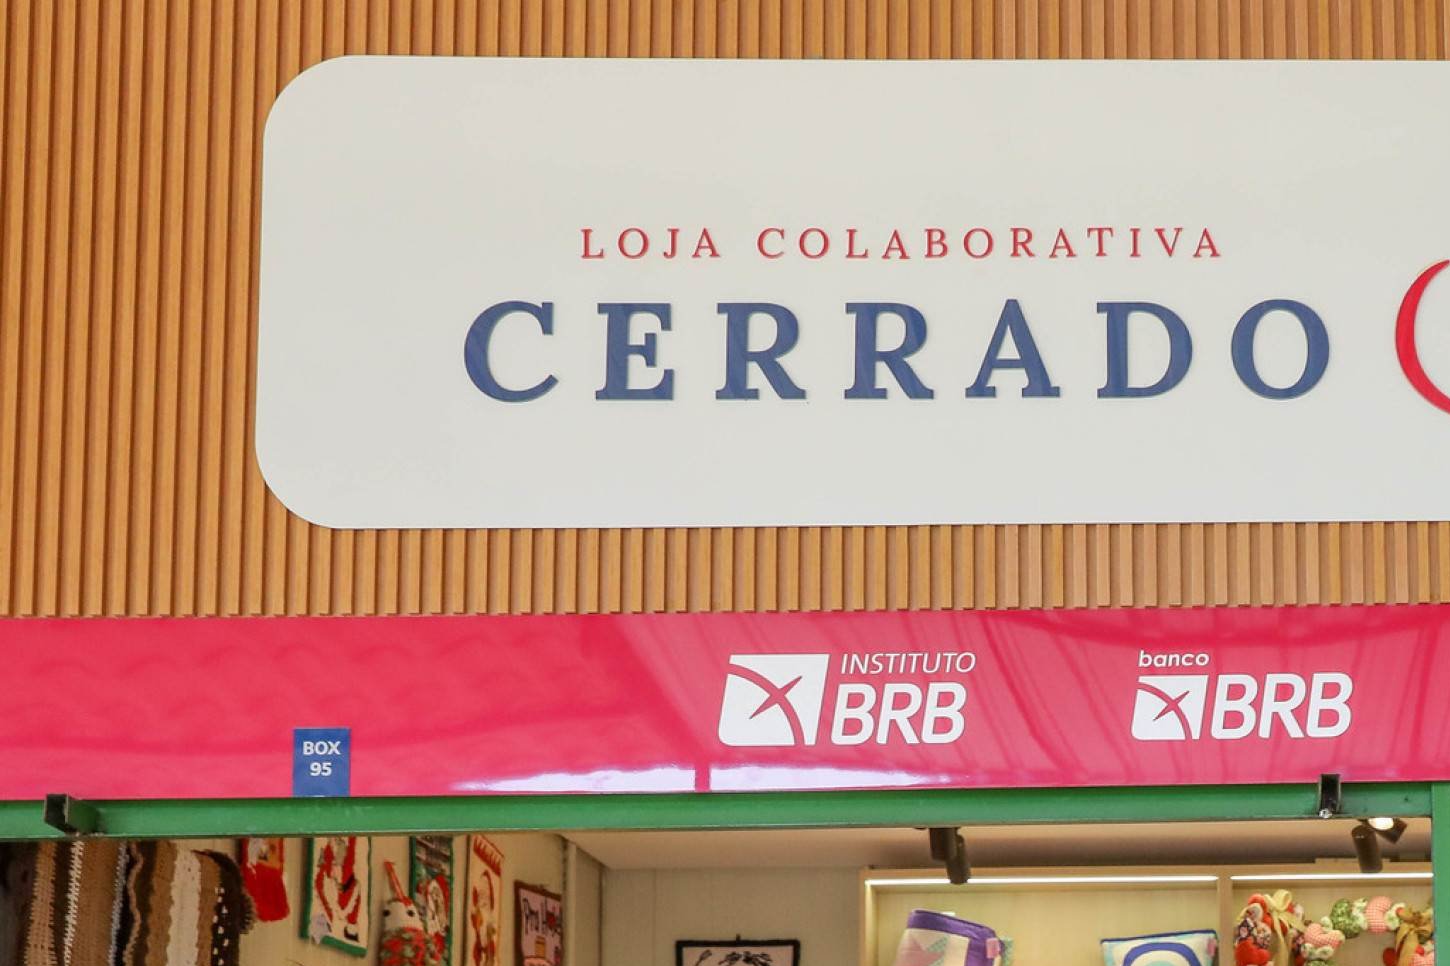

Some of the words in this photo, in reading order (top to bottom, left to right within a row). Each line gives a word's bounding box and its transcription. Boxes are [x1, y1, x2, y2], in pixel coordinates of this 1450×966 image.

[582, 227, 720, 260] LOJA
[756, 226, 1221, 261] COLABORATIVA
[463, 298, 1331, 402] CERRADO
[840, 651, 977, 674] INSTITUTO
[1137, 649, 1210, 668] banco
[831, 682, 968, 746] BRB
[1210, 671, 1354, 740] BRB
[302, 740, 342, 757] BOX
[308, 760, 333, 777] 95
